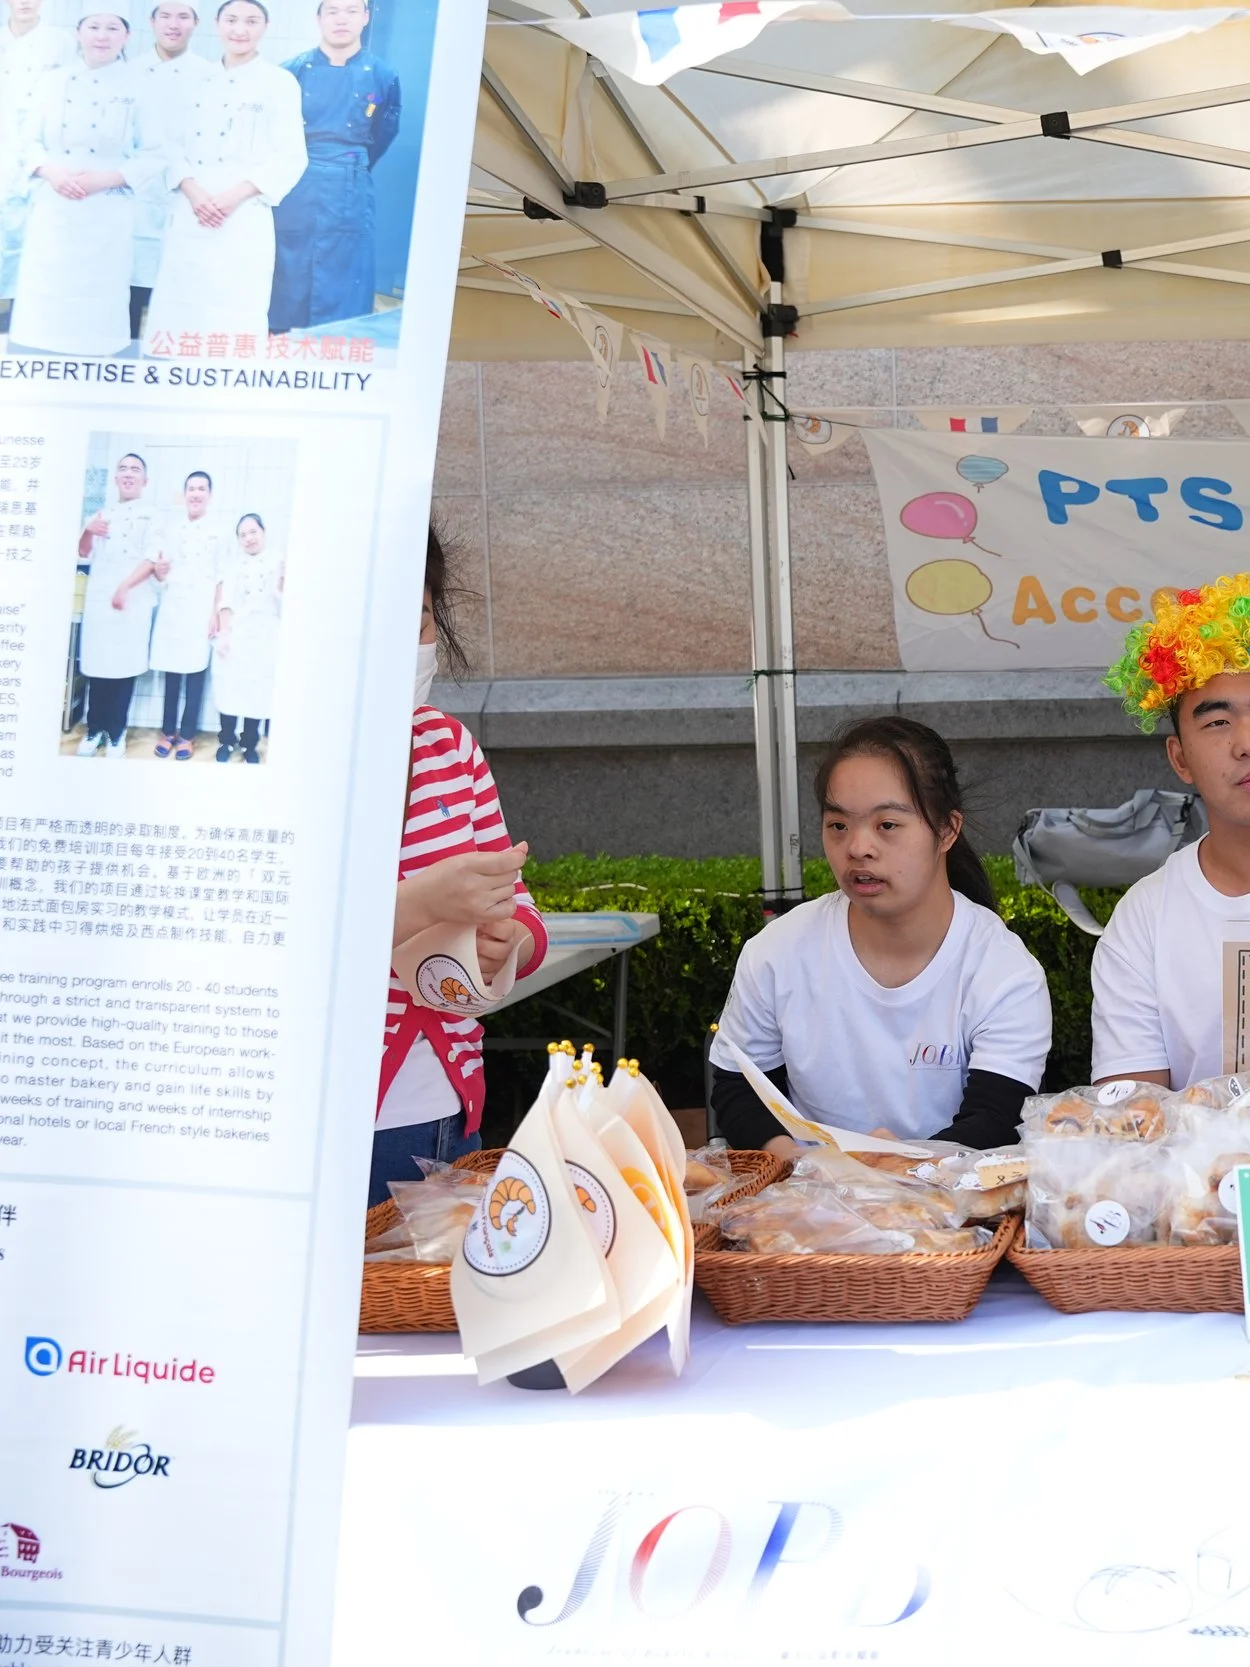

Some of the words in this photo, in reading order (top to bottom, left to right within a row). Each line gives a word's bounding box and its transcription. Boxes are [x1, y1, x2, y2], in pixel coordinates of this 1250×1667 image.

[149, 329, 258, 360] 公益普惠
[266, 332, 375, 363] 技术赋能
[0, 360, 136, 385] EXPERTISE
[144, 366, 160, 384] &
[168, 366, 373, 392] SUSTAINABILITY
[18, 971, 68, 988] training
[71, 976, 127, 992] program
[131, 977, 172, 991] enrolls
[176, 980, 191, 992] 20
[204, 981, 220, 995] 40
[224, 982, 278, 998] students
[52, 996, 60, 1006] a
[65, 994, 100, 1008] strict
[104, 997, 130, 1010] and
[135, 998, 210, 1017] transparent
[214, 1002, 261, 1020] system
[266, 1005, 280, 1019] to
[12, 1013, 32, 1024] we
[35, 1012, 87, 1030] provide
[172, 1020, 220, 1037] training
[224, 1022, 237, 1036] to
[241, 1023, 278, 1038] those
[12, 1031, 34, 1044] the
[81, 1035, 124, 1049] Based
[128, 1040, 144, 1050] on
[148, 1038, 169, 1051] the
[173, 1040, 234, 1057] European
[115, 1057, 138, 1070] the
[144, 1059, 221, 1075] curriculum
[228, 1063, 275, 1079] allows
[14, 1072, 65, 1086] master
[70, 1075, 119, 1092] bakery
[124, 1078, 151, 1091] and
[155, 1079, 184, 1095] gain
[190, 1081, 210, 1095] life
[216, 1082, 250, 1097] skills
[256, 1085, 273, 1101] by
[46, 1094, 61, 1107] of
[63, 1095, 114, 1113] training
[117, 1098, 142, 1112] and
[147, 1100, 186, 1114] weeks
[191, 1102, 204, 1116] of
[208, 1103, 271, 1122] internship
[28, 1114, 71, 1128] hotels
[75, 1118, 90, 1129] or
[94, 1117, 126, 1131] local
[130, 1119, 175, 1133] French
[179, 1122, 210, 1138] style
[214, 1123, 270, 1139] bakeries
[68, 1350, 108, 1374] Air
[113, 1353, 215, 1384] Liquide
[69, 1446, 171, 1479] BRIDOR
[1, 1566, 63, 1581] Bourgeois
